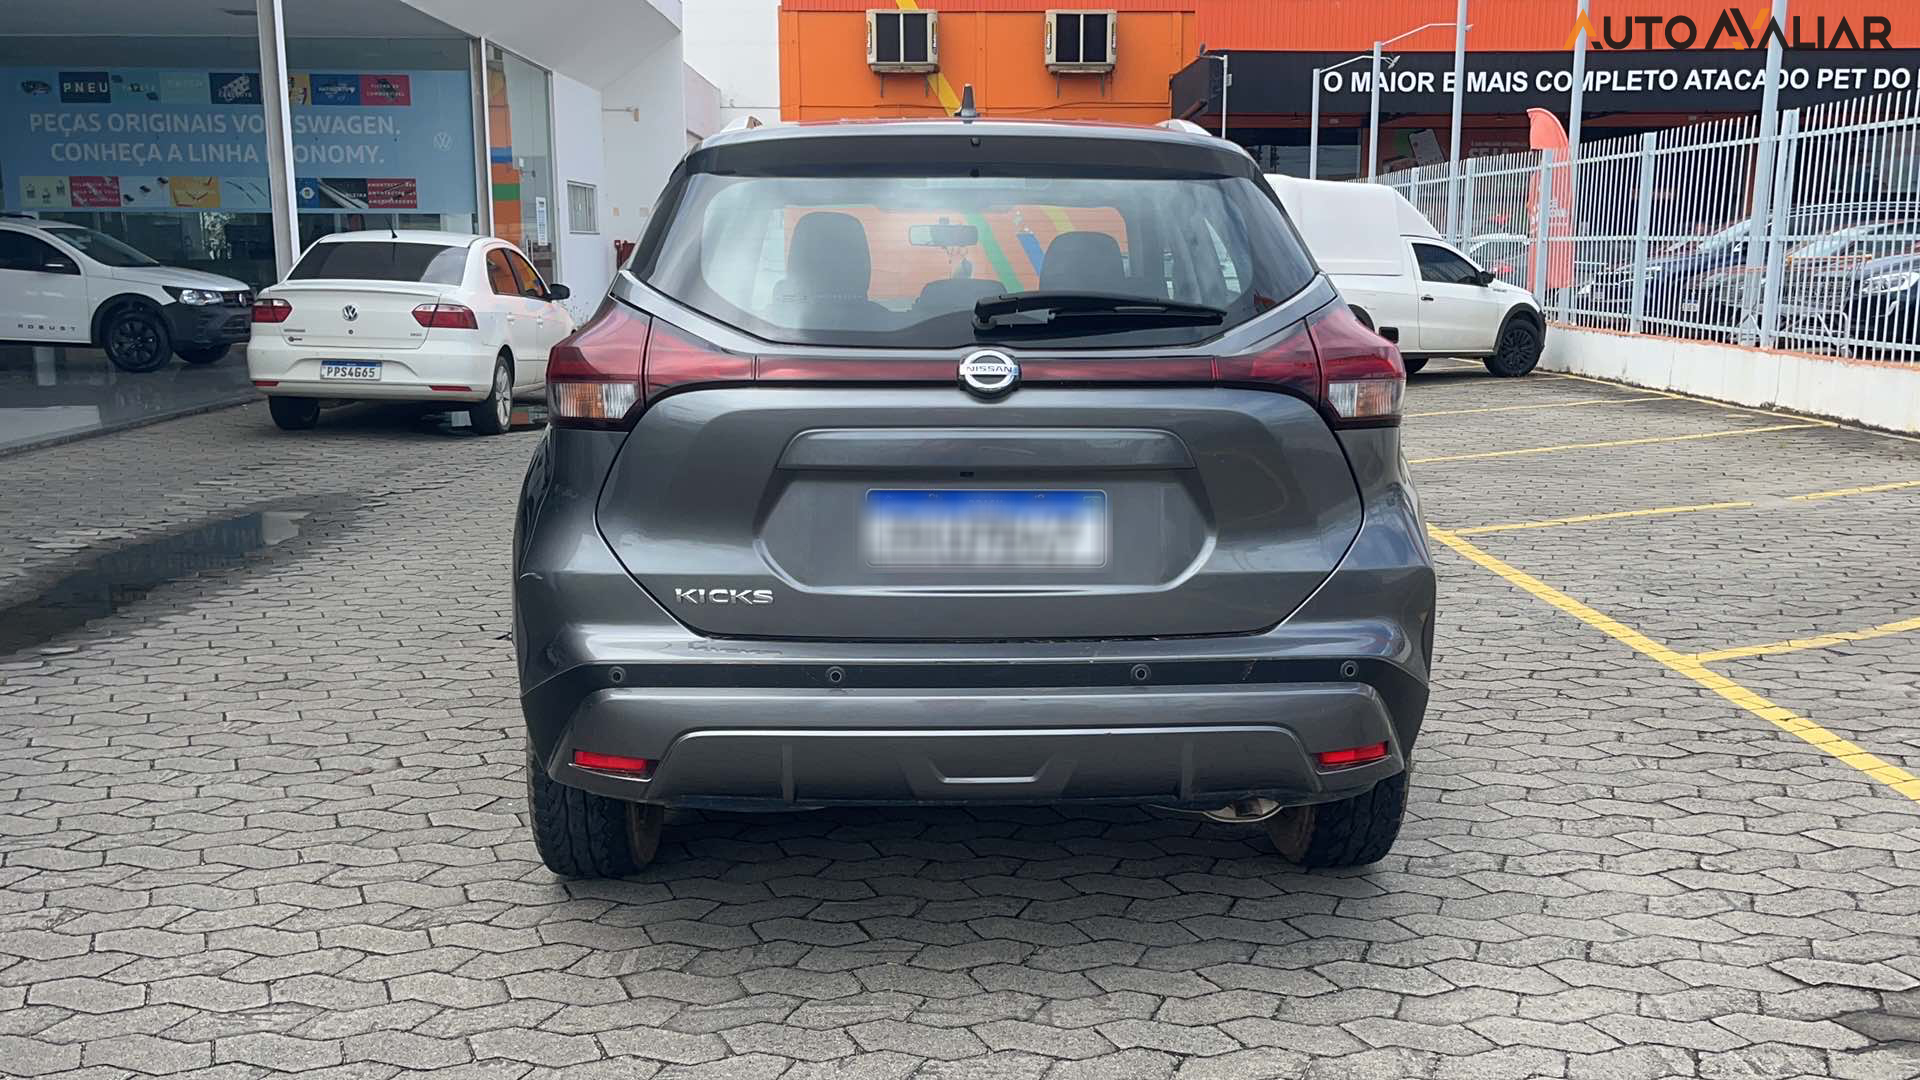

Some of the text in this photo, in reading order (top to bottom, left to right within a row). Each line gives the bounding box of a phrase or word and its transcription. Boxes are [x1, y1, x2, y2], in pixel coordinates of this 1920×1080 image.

[62, 82, 109, 93] PNEU
[1323, 71, 1343, 93] O
[1351, 71, 1435, 93] MAIOR
[1443, 71, 1456, 93] E
[1467, 71, 1528, 92] MAIS
[1535, 69, 1678, 92] COMPLETO
[1817, 68, 1867, 89] PET
[1873, 67, 1911, 89] DO
[30, 113, 400, 137] PEÇAS ORIGINAIS VOSWAGEN.
[51, 143, 162, 167] CONHEÇA
[168, 144, 183, 161] A
[189, 144, 259, 162] LINHA
[326, 367, 376, 378] PPS4G65
[675, 588, 774, 605] KICKS
